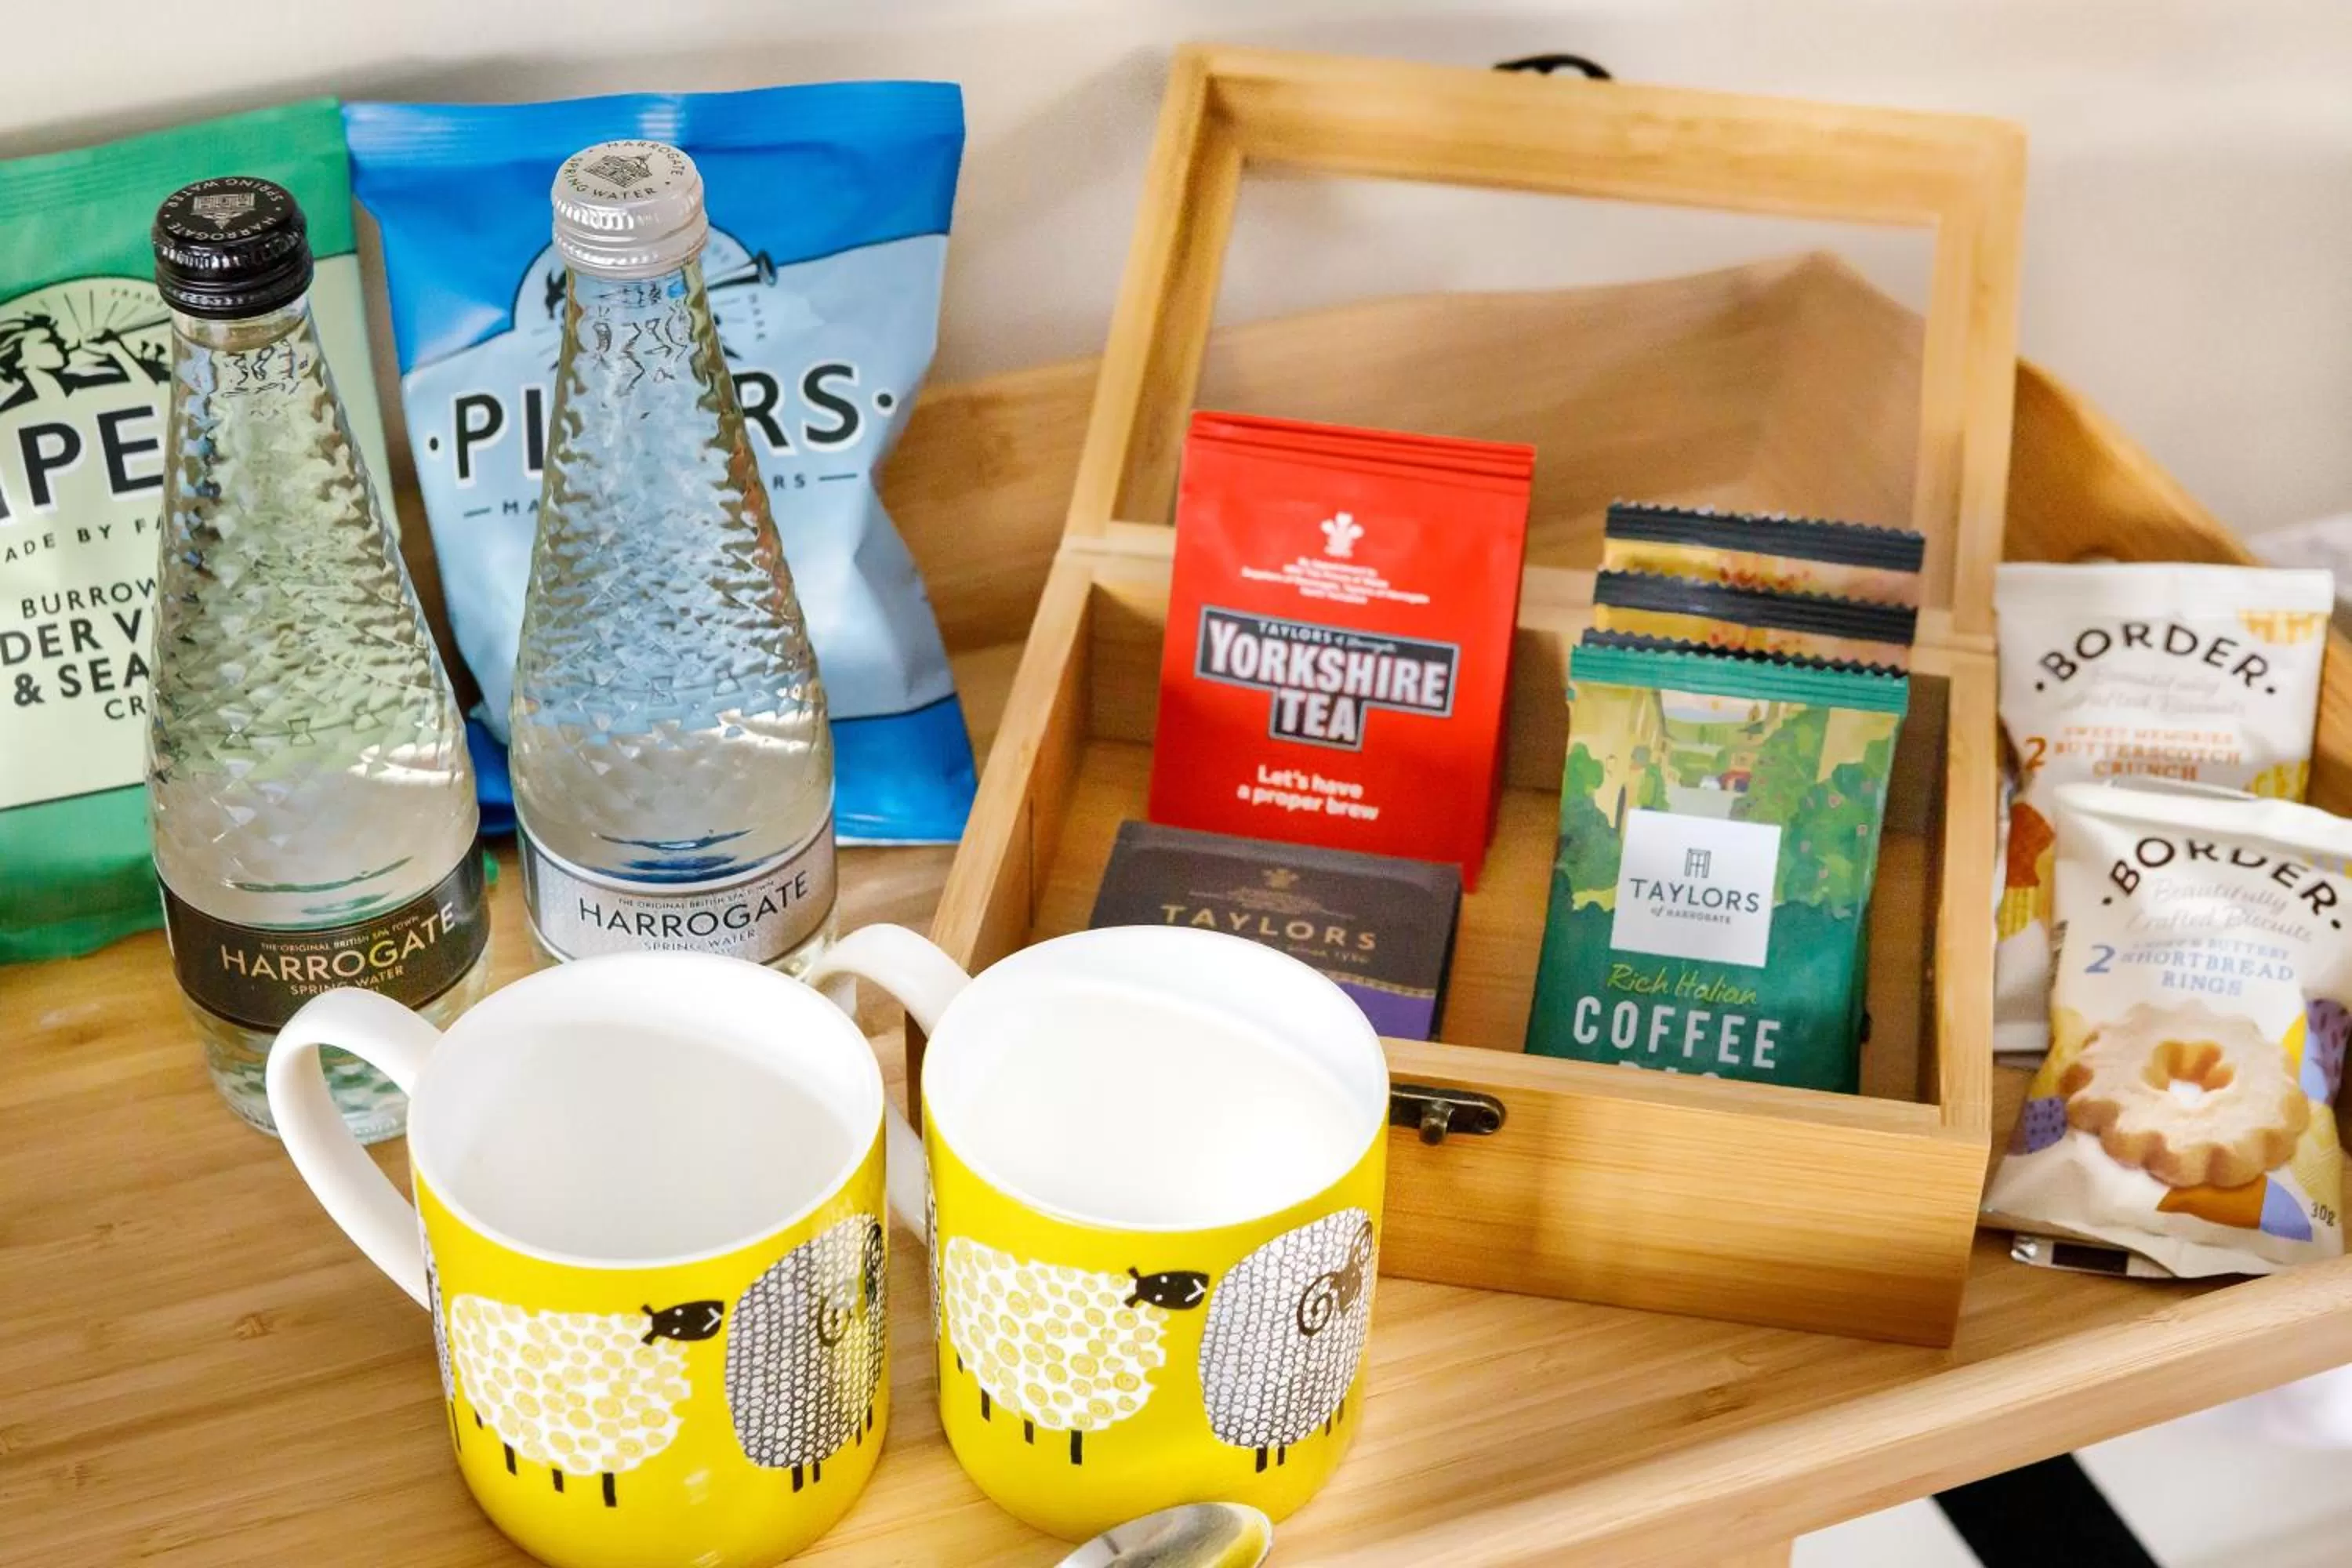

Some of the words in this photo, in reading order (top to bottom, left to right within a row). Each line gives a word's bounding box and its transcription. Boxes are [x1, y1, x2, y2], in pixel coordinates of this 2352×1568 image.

[606, 141, 686, 176] HARROGATE
[165, 180, 220, 208] WATER
[224, 177, 285, 202] SPRING
[593, 187, 657, 200] WATER
[165, 215, 278, 241] HARROGATE
[453, 362, 861, 481] PIRS
[76, 524, 112, 544] BY
[1258, 621, 1332, 644] TAYLORS
[1207, 619, 1449, 708] YORKSHIRE
[2040, 621, 2269, 688] BORDER
[13, 672, 45, 707] &
[57, 651, 150, 699] SEA
[1278, 689, 1357, 743] TEA
[2024, 735, 2049, 771] 2
[1257, 764, 1309, 791] Let's
[1311, 772, 1364, 800] have
[1236, 784, 1250, 800] a
[1251, 786, 1324, 813] proper
[1326, 795, 1380, 821] brew
[579, 869, 808, 939] HARROGATE
[637, 901, 685, 910] ORIGINAL
[689, 897, 724, 909] BRITISH
[1629, 877, 1760, 913] TAYLORS
[280, 942, 331, 953] ORIGINAL
[333, 935, 370, 949] BRITISH
[392, 915, 420, 933] TOWN
[1160, 902, 1377, 951] TAYLORS
[1666, 909, 1731, 925] HARROGATE
[220, 901, 457, 982] HARROGATE
[707, 929, 756, 949] WATER
[354, 964, 405, 988] WATER
[2083, 944, 2117, 975] 2
[1608, 963, 1669, 994] Rich
[1674, 963, 1758, 1004] Italian
[2161, 970, 2244, 998] RINGS
[1572, 995, 1783, 1069] COFFEE
[2310, 1201, 2336, 1230] 30g
